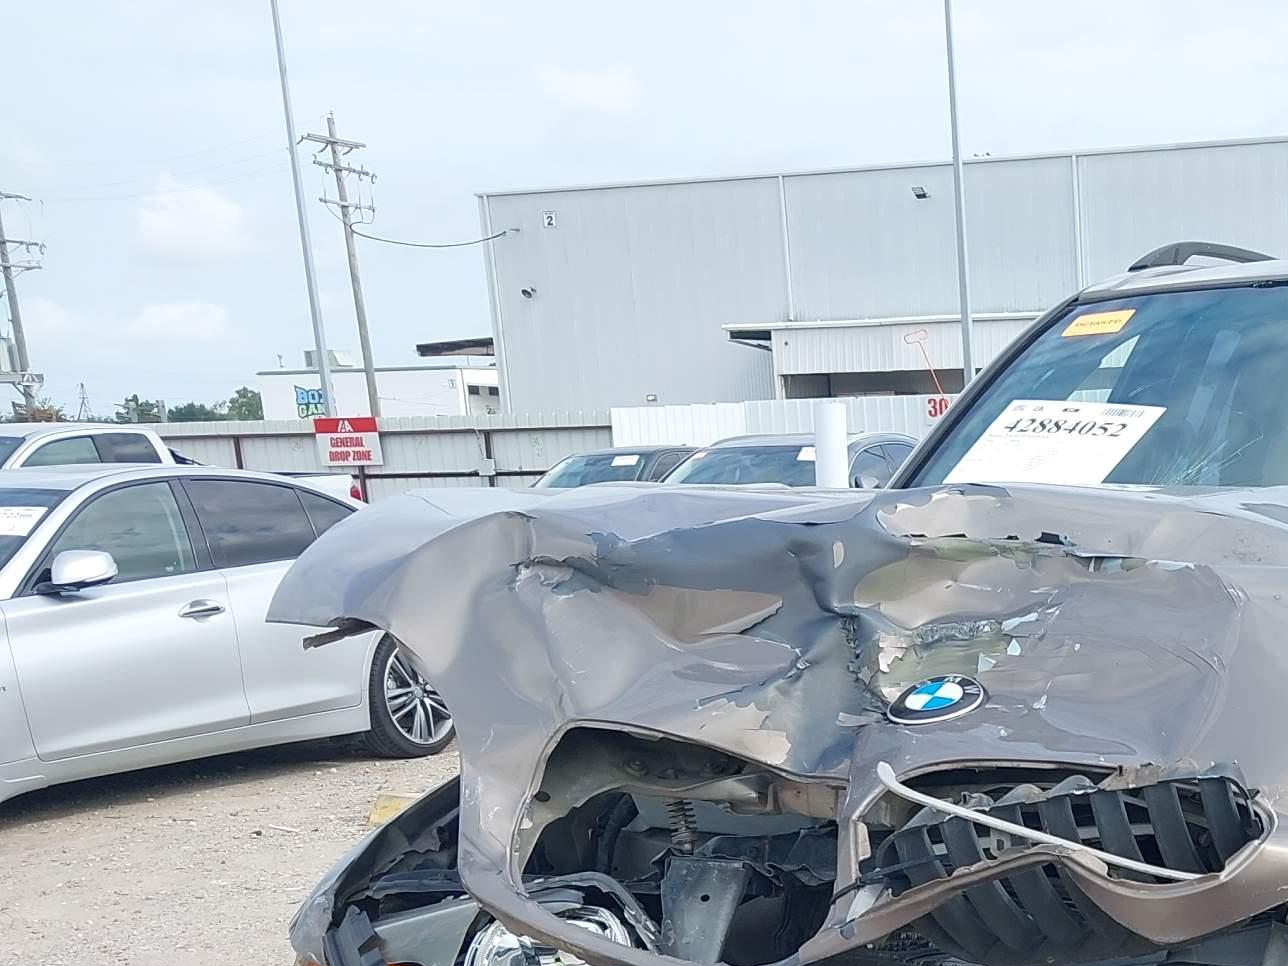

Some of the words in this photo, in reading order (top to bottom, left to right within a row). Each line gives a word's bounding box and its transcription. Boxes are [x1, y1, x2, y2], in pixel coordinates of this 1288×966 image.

[546, 215, 554, 226] 2
[928, 398, 948, 417] 30
[1004, 418, 1128, 437] 42884052
[330, 436, 365, 448] GENERAL
[328, 450, 351, 461] DROP
[351, 450, 372, 461] ZONE
